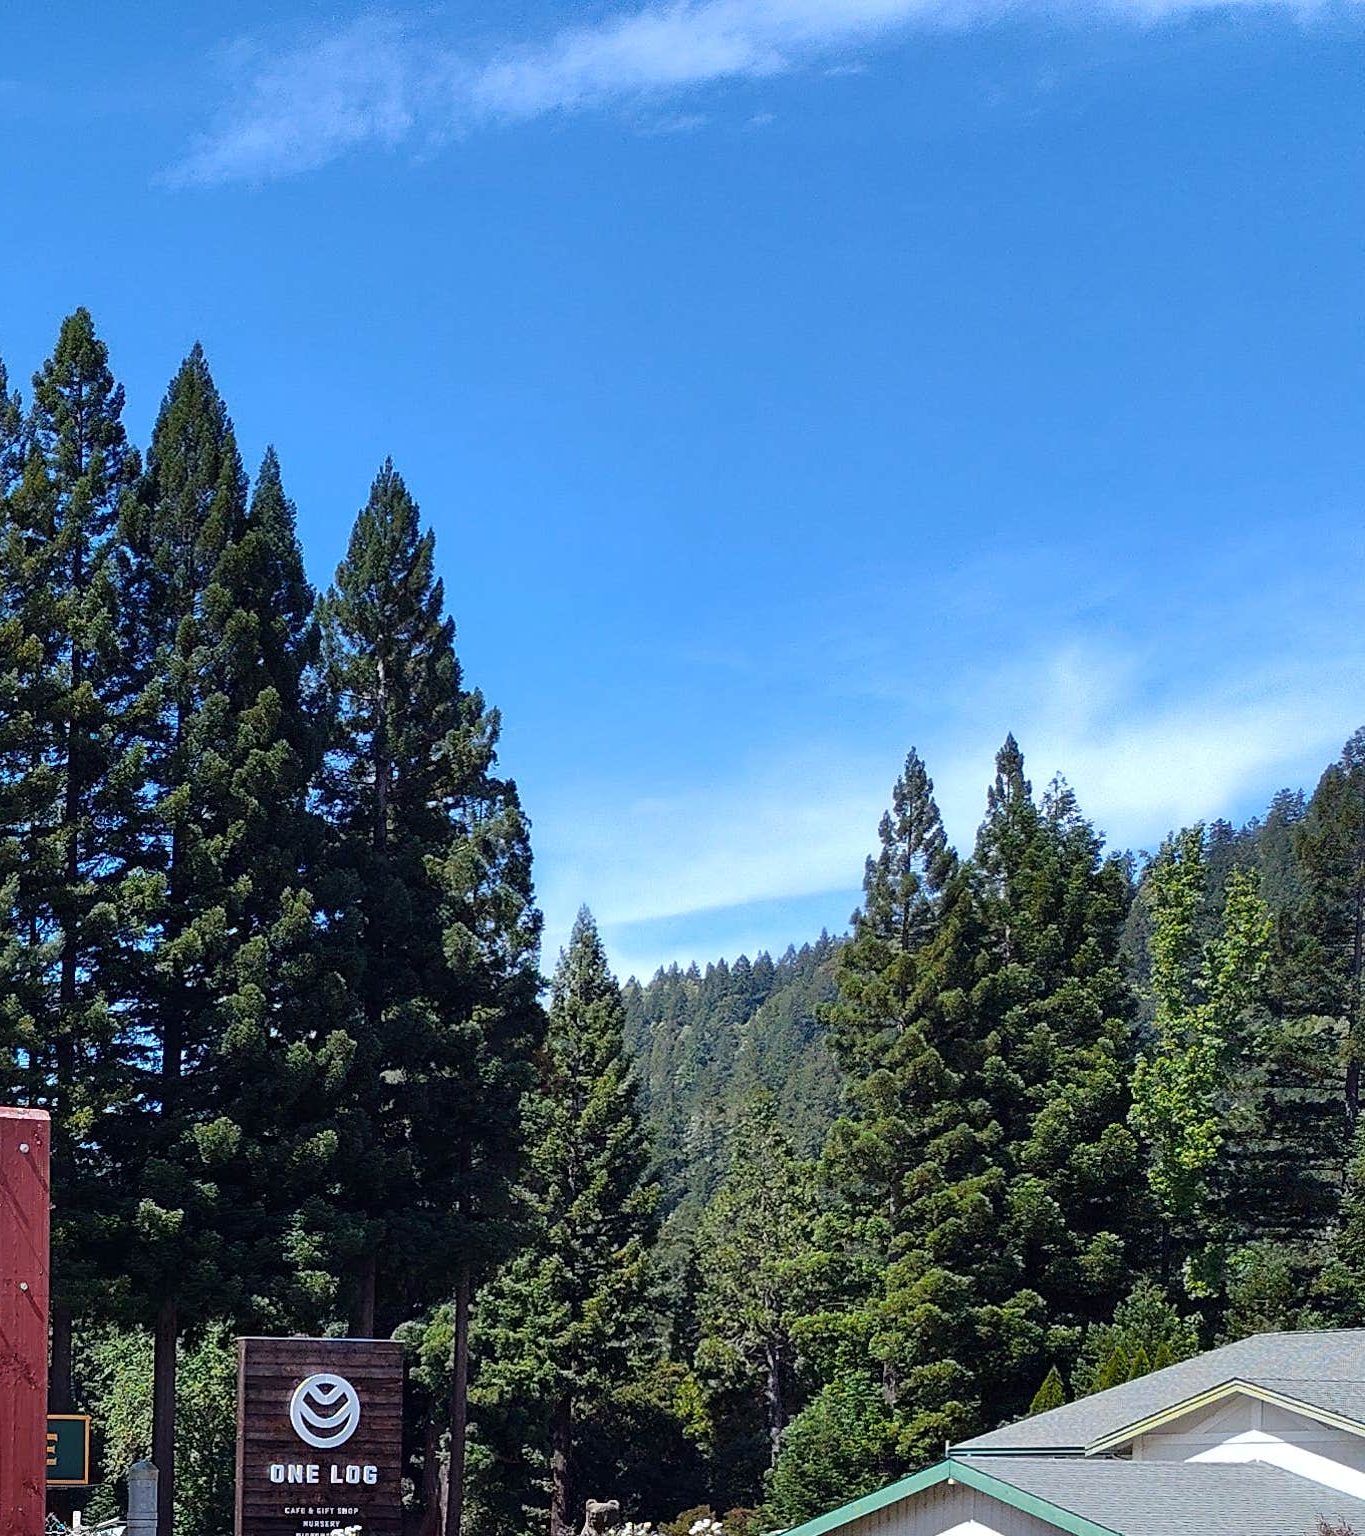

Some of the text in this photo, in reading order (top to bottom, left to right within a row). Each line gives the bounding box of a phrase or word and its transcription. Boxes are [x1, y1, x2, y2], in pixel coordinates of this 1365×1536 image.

[269, 1464, 378, 1484] ONE LOG
[302, 1520, 341, 1528] NURSERY
